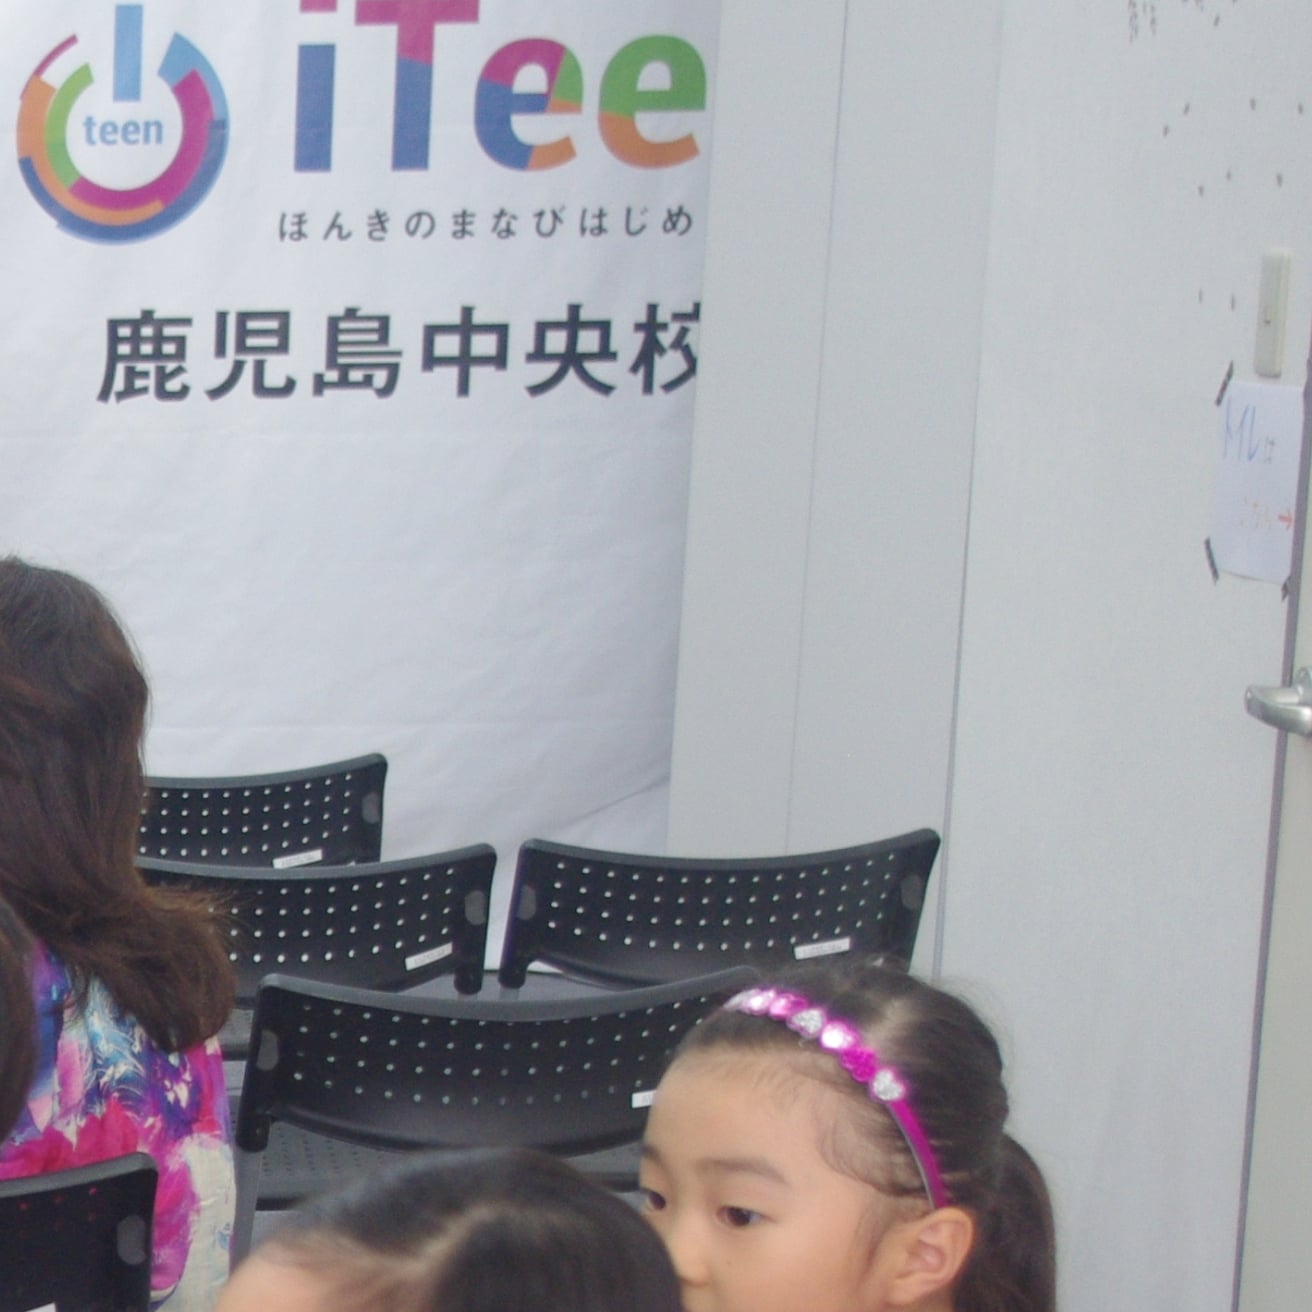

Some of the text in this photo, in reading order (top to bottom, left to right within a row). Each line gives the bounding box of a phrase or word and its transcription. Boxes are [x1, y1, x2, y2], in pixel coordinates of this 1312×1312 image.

[82, 111, 164, 147] teen
[279, 206, 695, 242] ほんきのまなびはじめ
[96, 303, 702, 405] 鹿児島中央校
